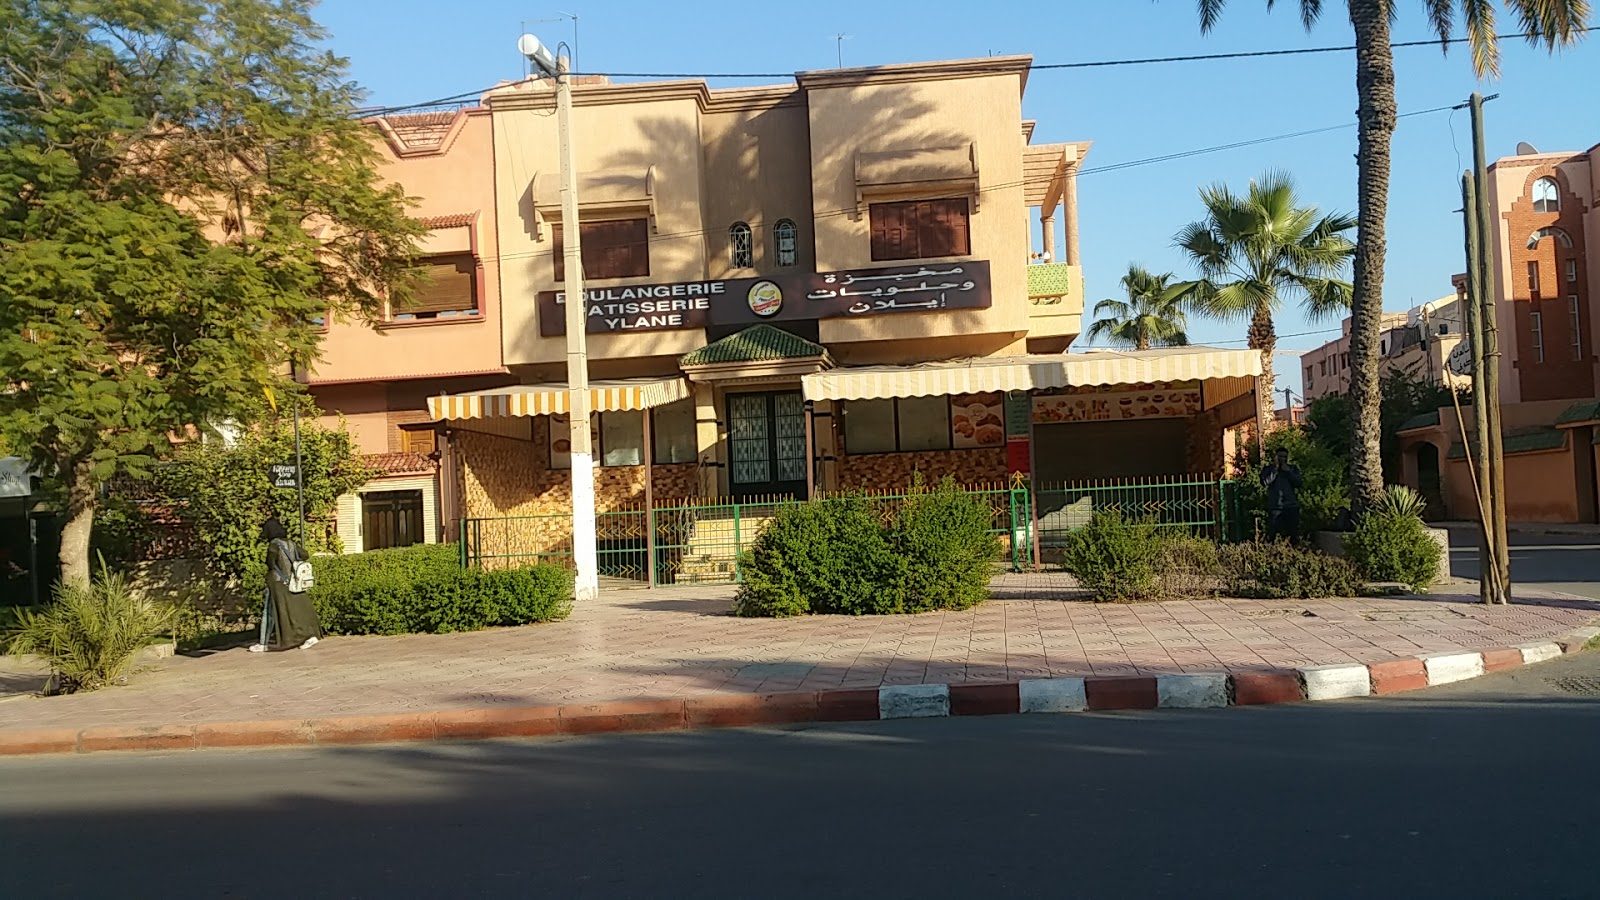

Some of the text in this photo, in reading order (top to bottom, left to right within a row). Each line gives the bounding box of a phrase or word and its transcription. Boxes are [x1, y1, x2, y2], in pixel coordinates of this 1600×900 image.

[823, 266, 963, 285] مخبزة
[807, 280, 975, 299] وحلويات
[583, 298, 709, 317] ATISSERIE
[605, 314, 682, 330] YLANE
